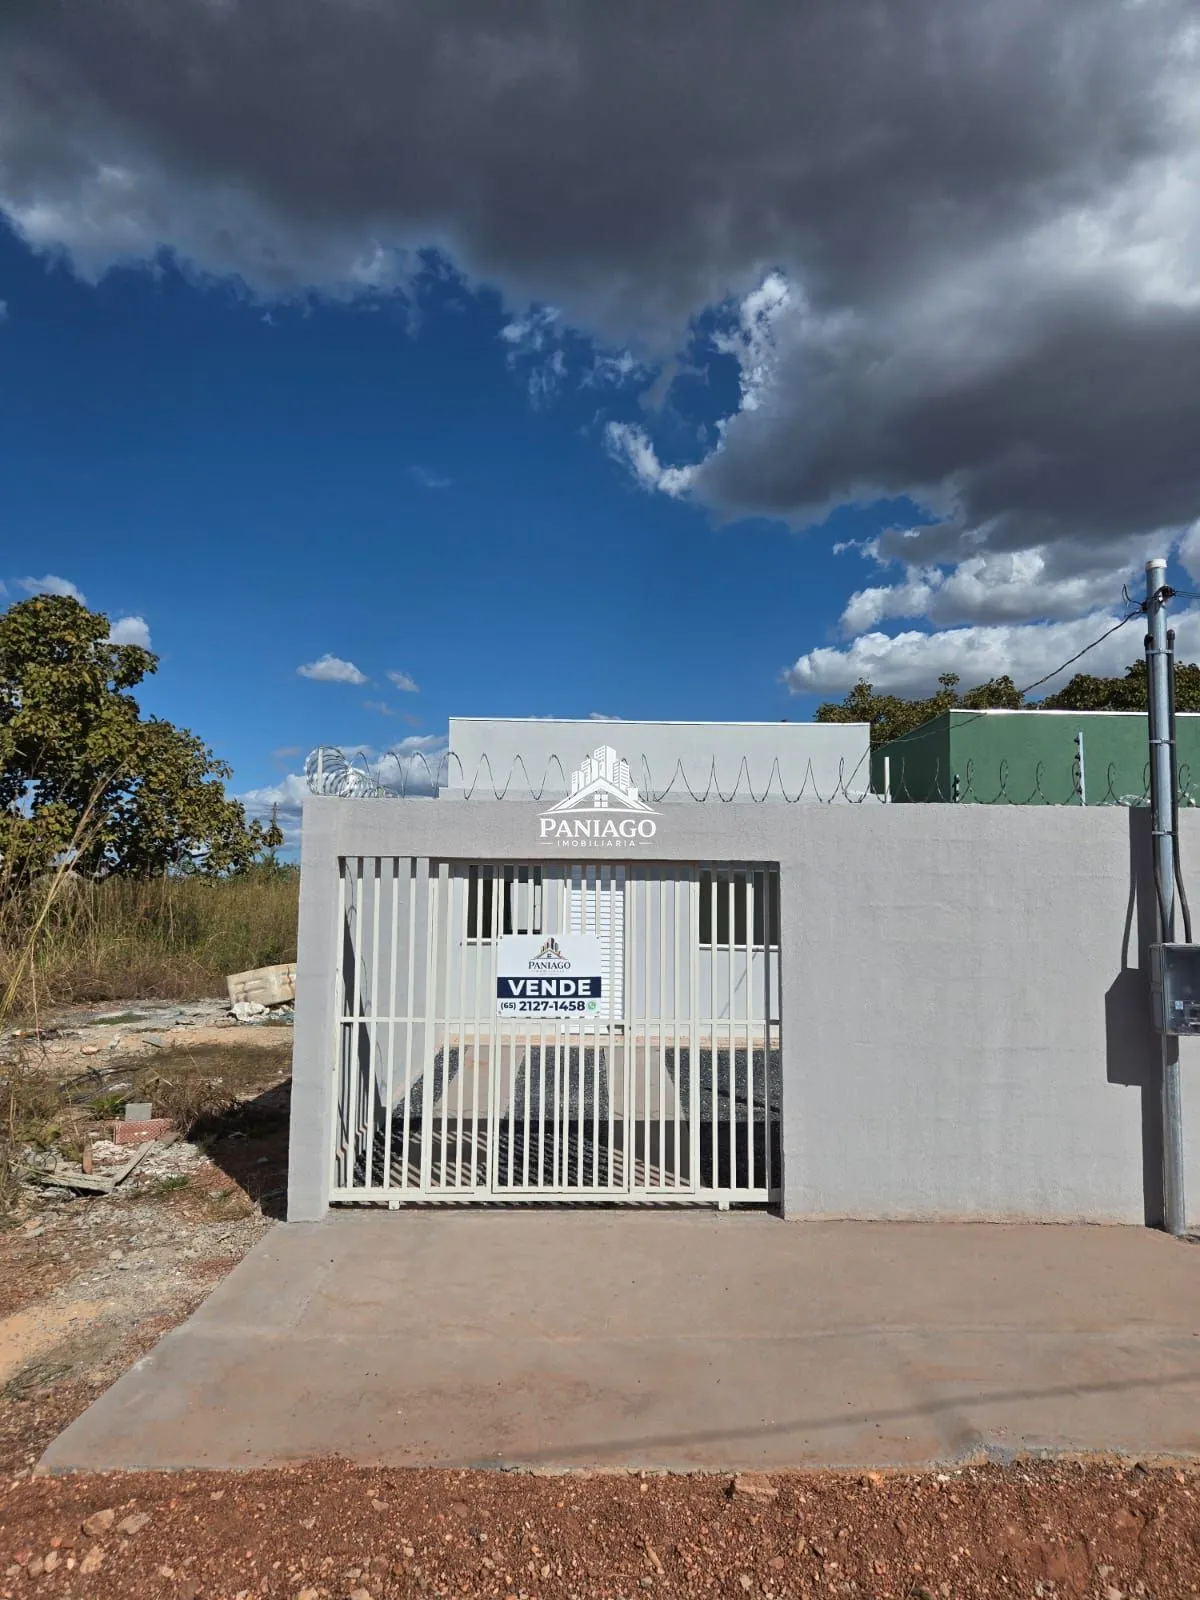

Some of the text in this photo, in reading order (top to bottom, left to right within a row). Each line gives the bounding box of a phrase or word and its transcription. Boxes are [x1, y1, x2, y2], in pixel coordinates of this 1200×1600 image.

[528, 961, 571, 970] PANIAGO
[508, 979, 592, 996] VENDE
[500, 1001, 585, 1011] (65) 2127-1458
